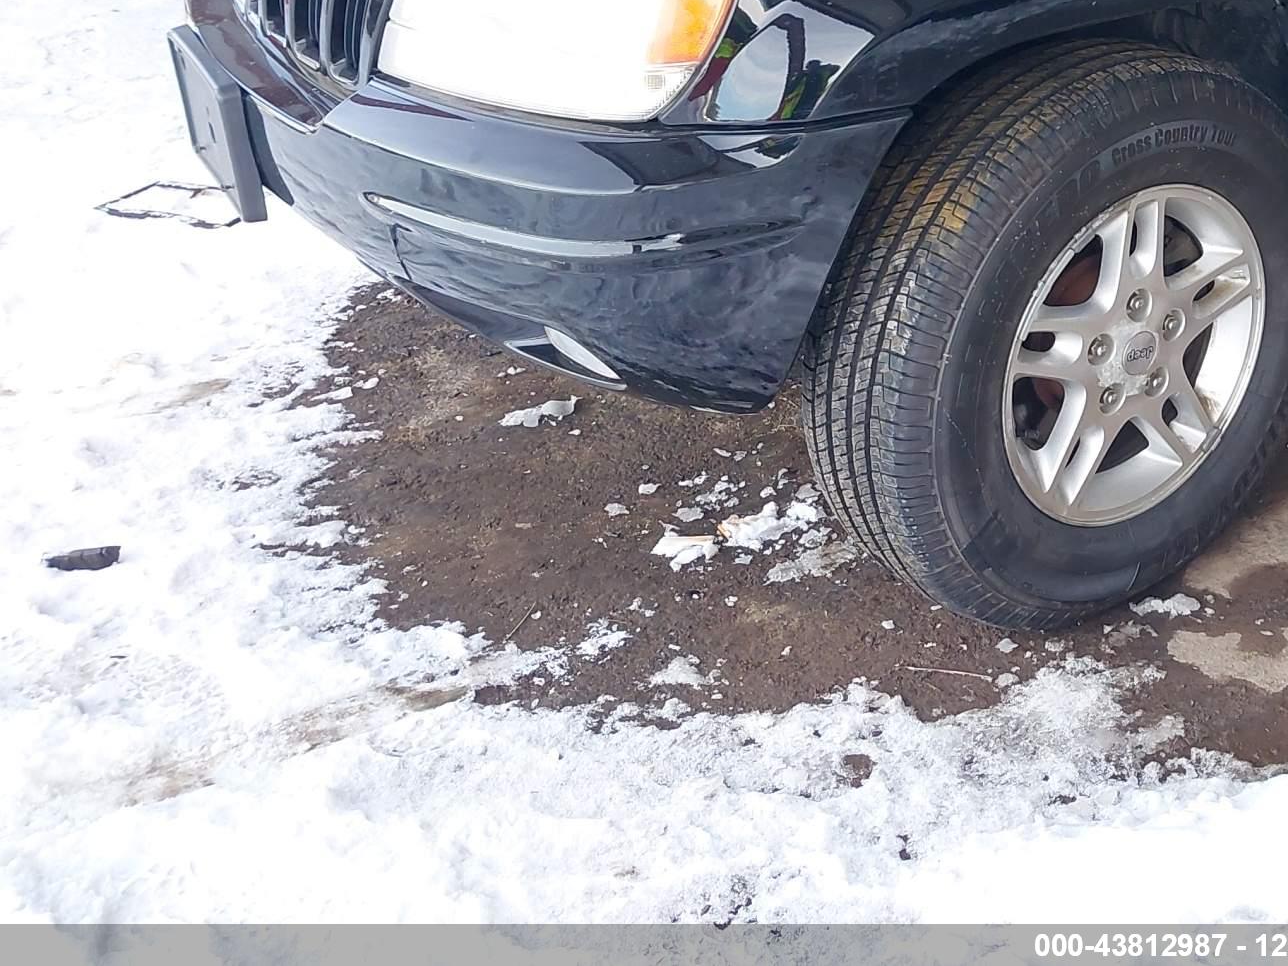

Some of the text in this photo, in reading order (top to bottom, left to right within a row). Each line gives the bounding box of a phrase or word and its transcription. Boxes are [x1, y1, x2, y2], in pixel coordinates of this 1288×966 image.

[1111, 123, 1238, 167] Cross Country Tour
[1127, 346, 1153, 362] Jeep
